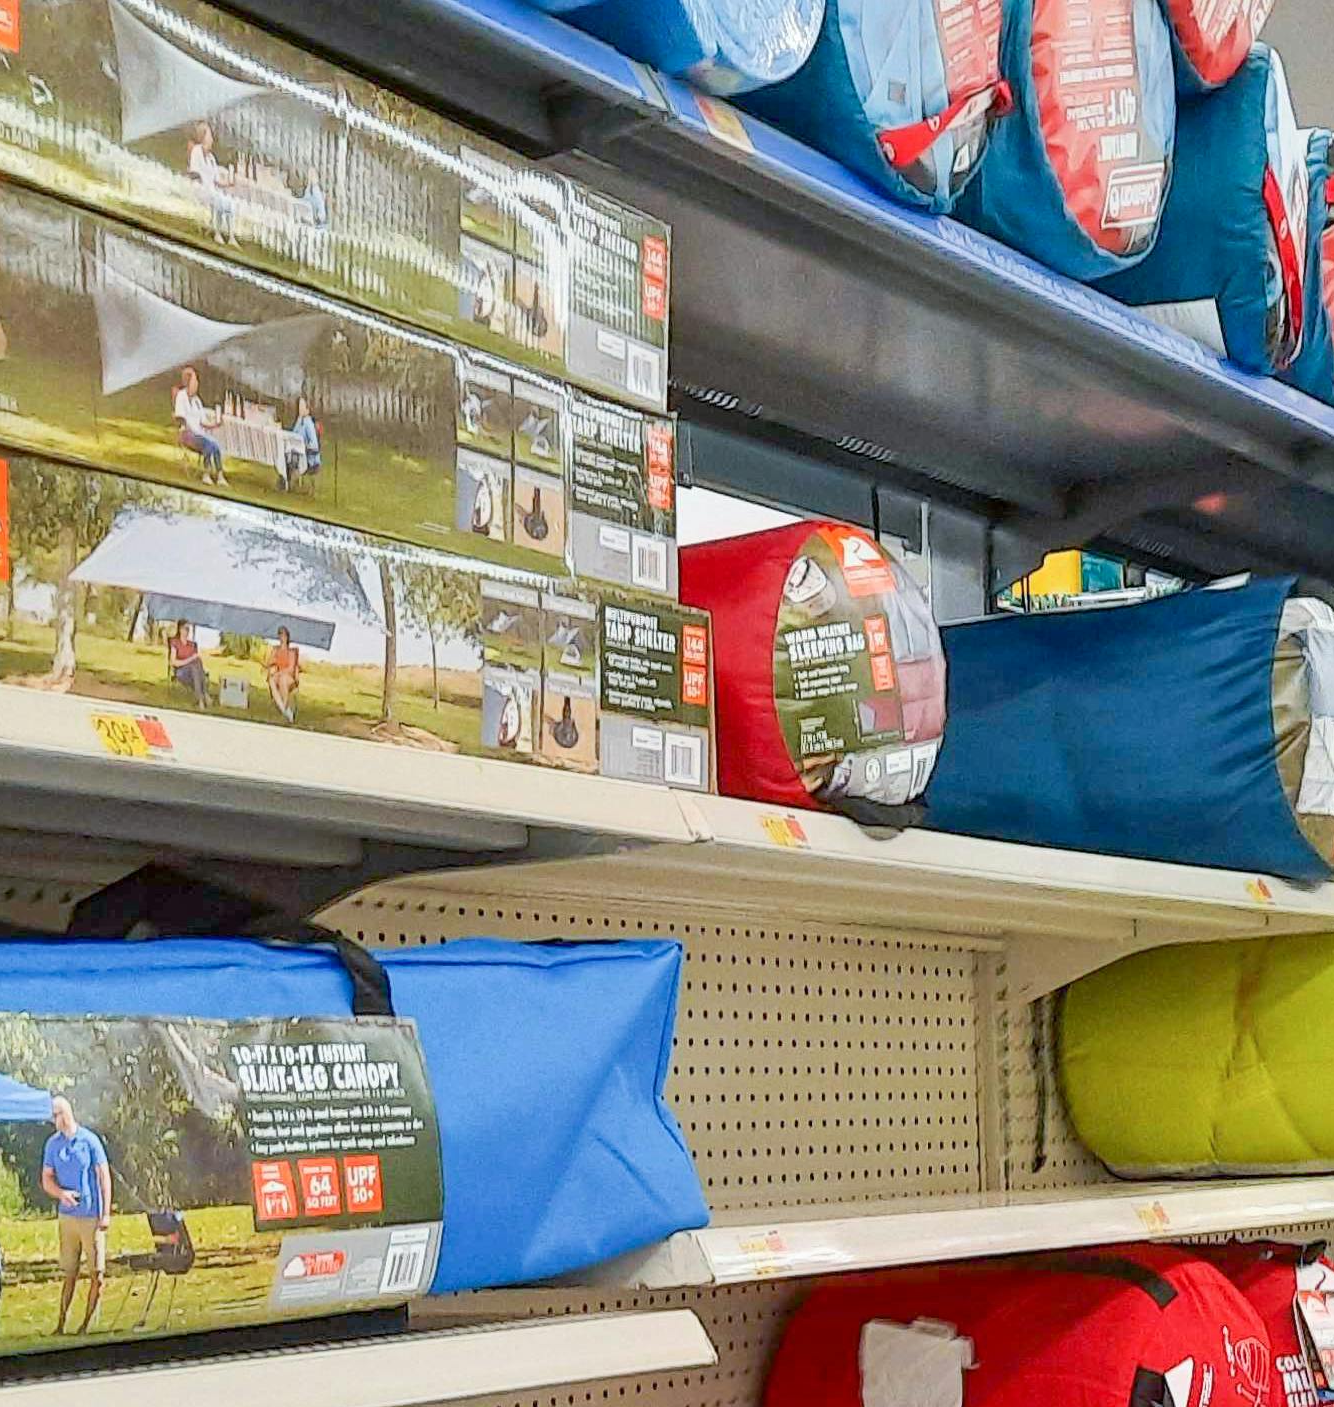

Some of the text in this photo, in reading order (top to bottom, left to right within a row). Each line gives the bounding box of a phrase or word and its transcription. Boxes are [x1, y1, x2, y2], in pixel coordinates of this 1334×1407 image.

[606, 620, 677, 655] TARP SHELTER
[788, 637, 844, 662] SLEEPING
[844, 632, 866, 652] BAG
[231, 1044, 268, 1065] 10-FT
[280, 1044, 315, 1065] 10-FT
[318, 1043, 367, 1063] INSTANT
[238, 1062, 400, 1093] SLANT-LEG CANOPY
[309, 1175, 332, 1196] 64
[347, 1165, 377, 1187] UPF
